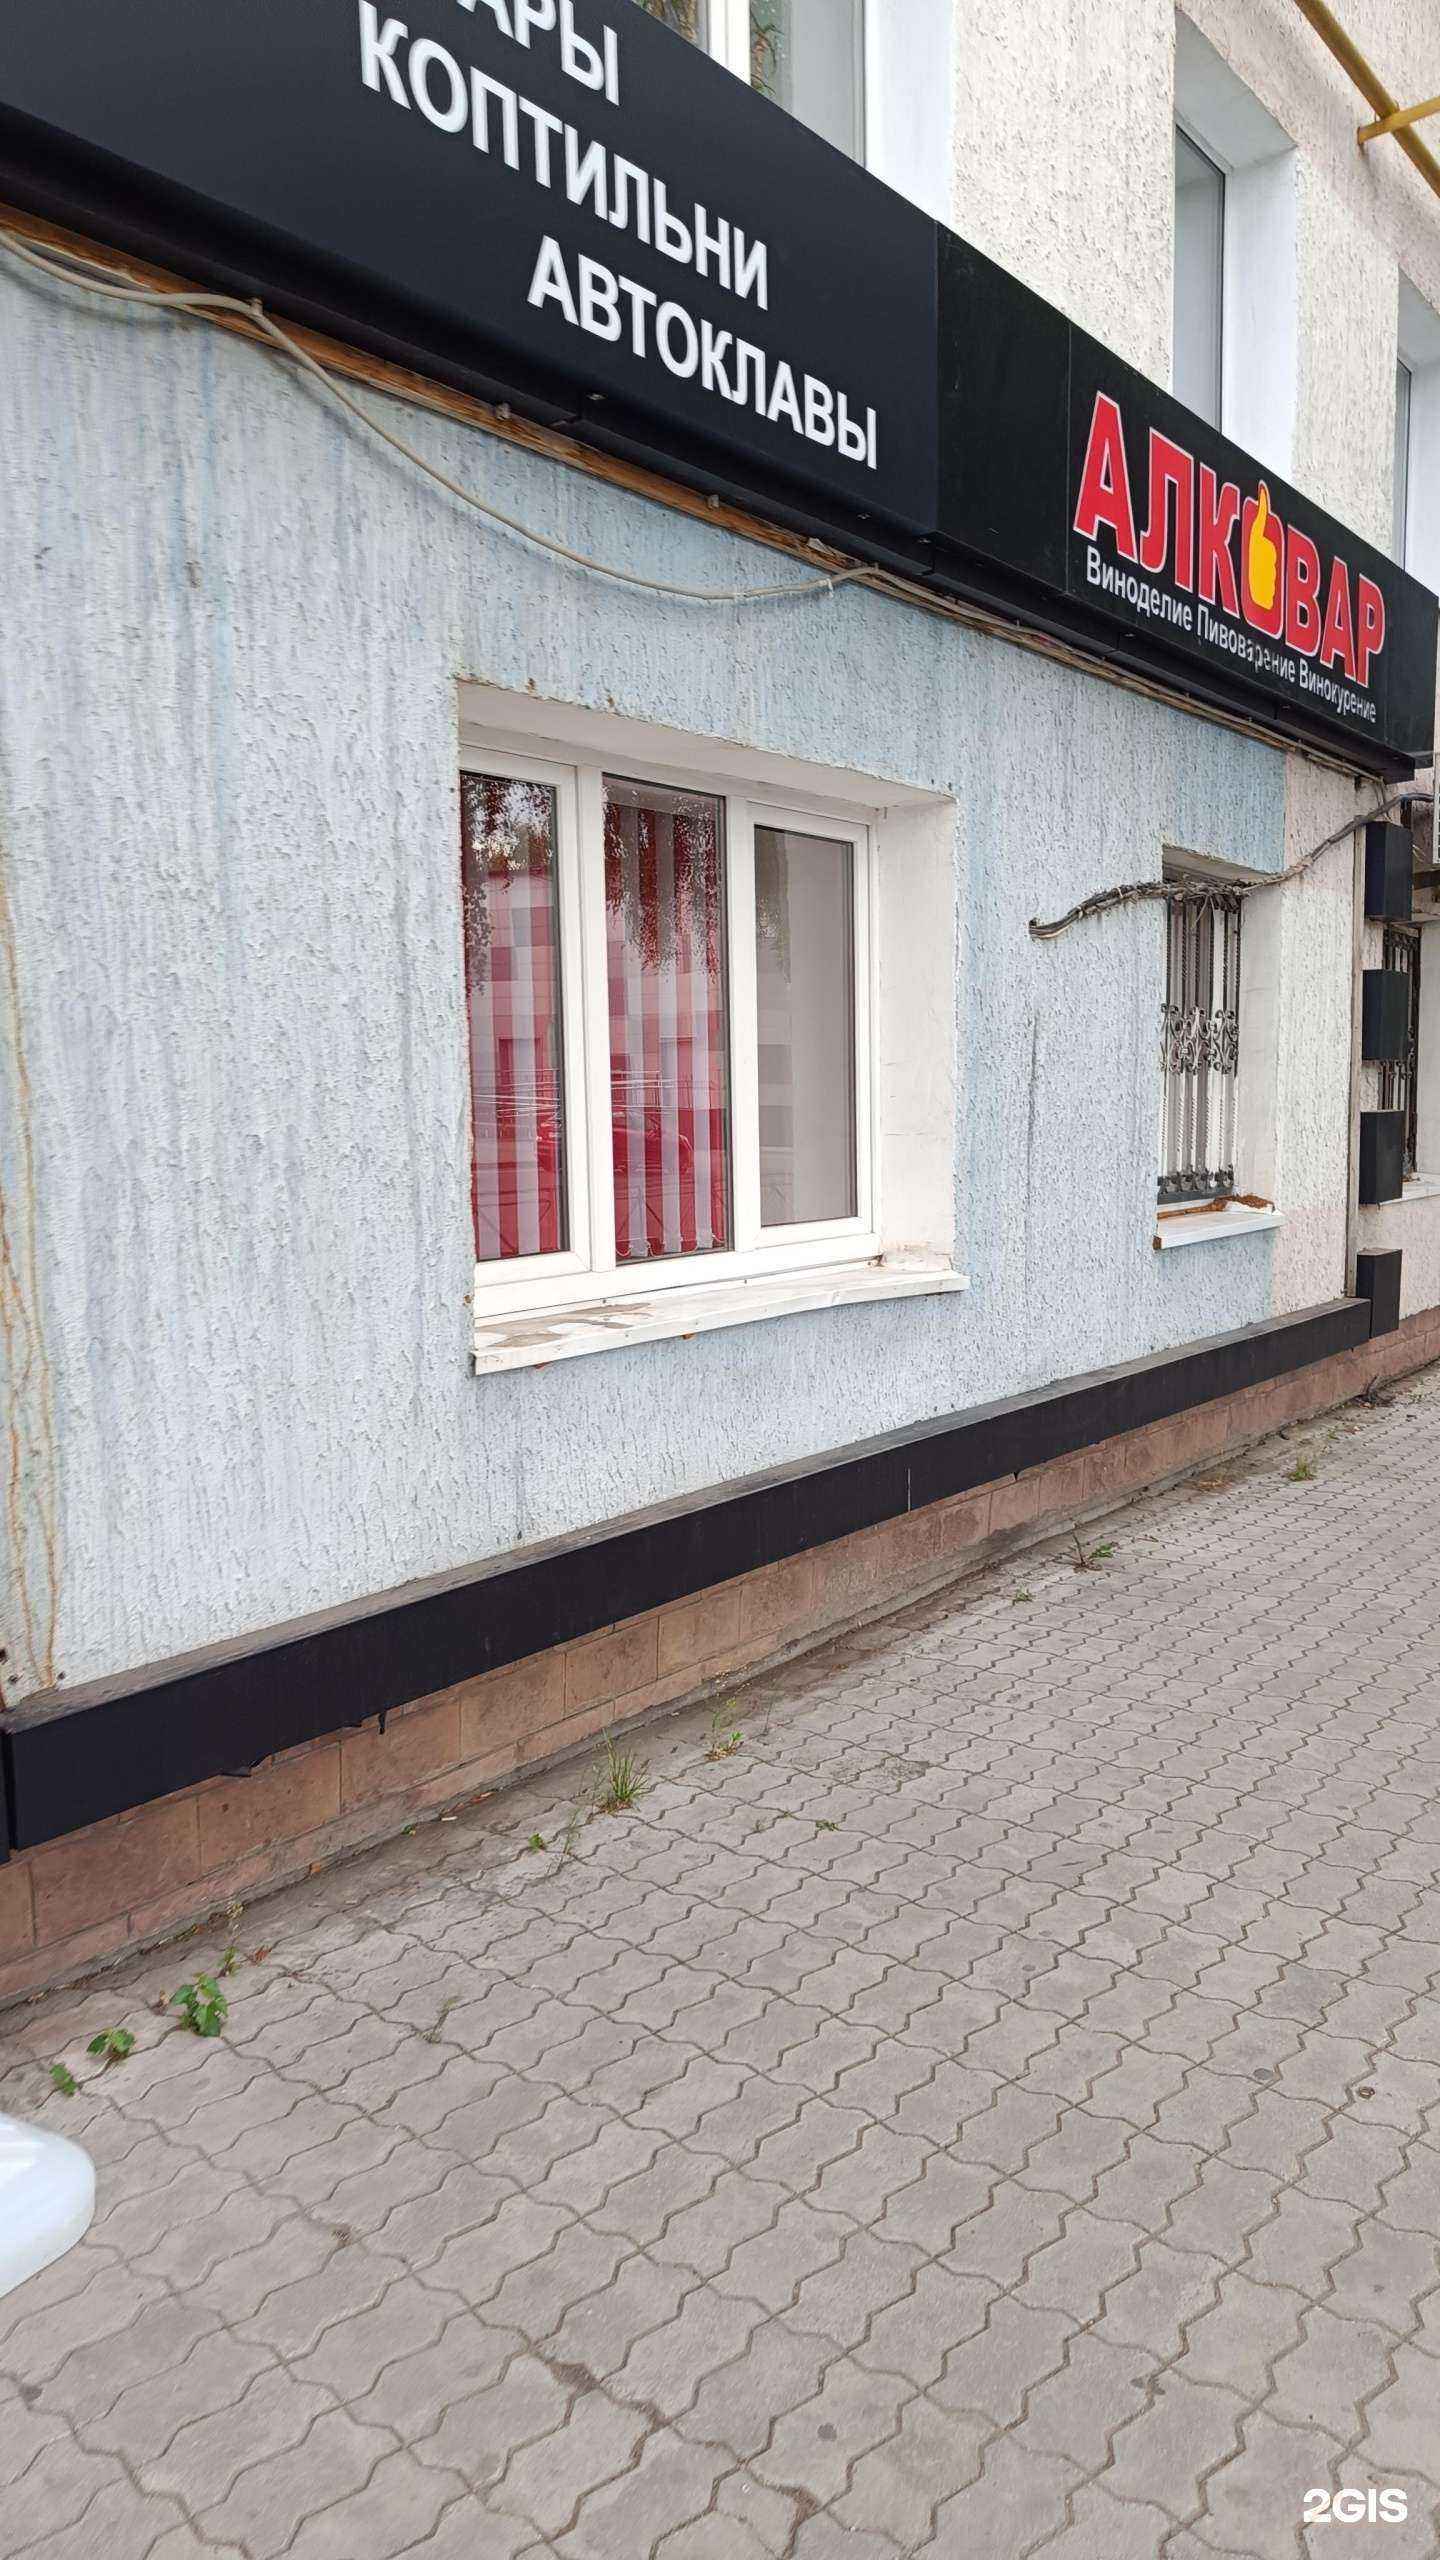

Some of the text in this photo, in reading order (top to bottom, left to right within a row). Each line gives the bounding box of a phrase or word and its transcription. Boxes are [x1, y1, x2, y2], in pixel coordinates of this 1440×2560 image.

[359, 0, 768, 311] КОПТИЛЬНИ
[527, 234, 878, 470] АВТОКЛАВЫ
[1073, 390, 1386, 688] АЛКОВАР
[1086, 545, 1377, 723] Виноделие Пивоварение Винокурение
